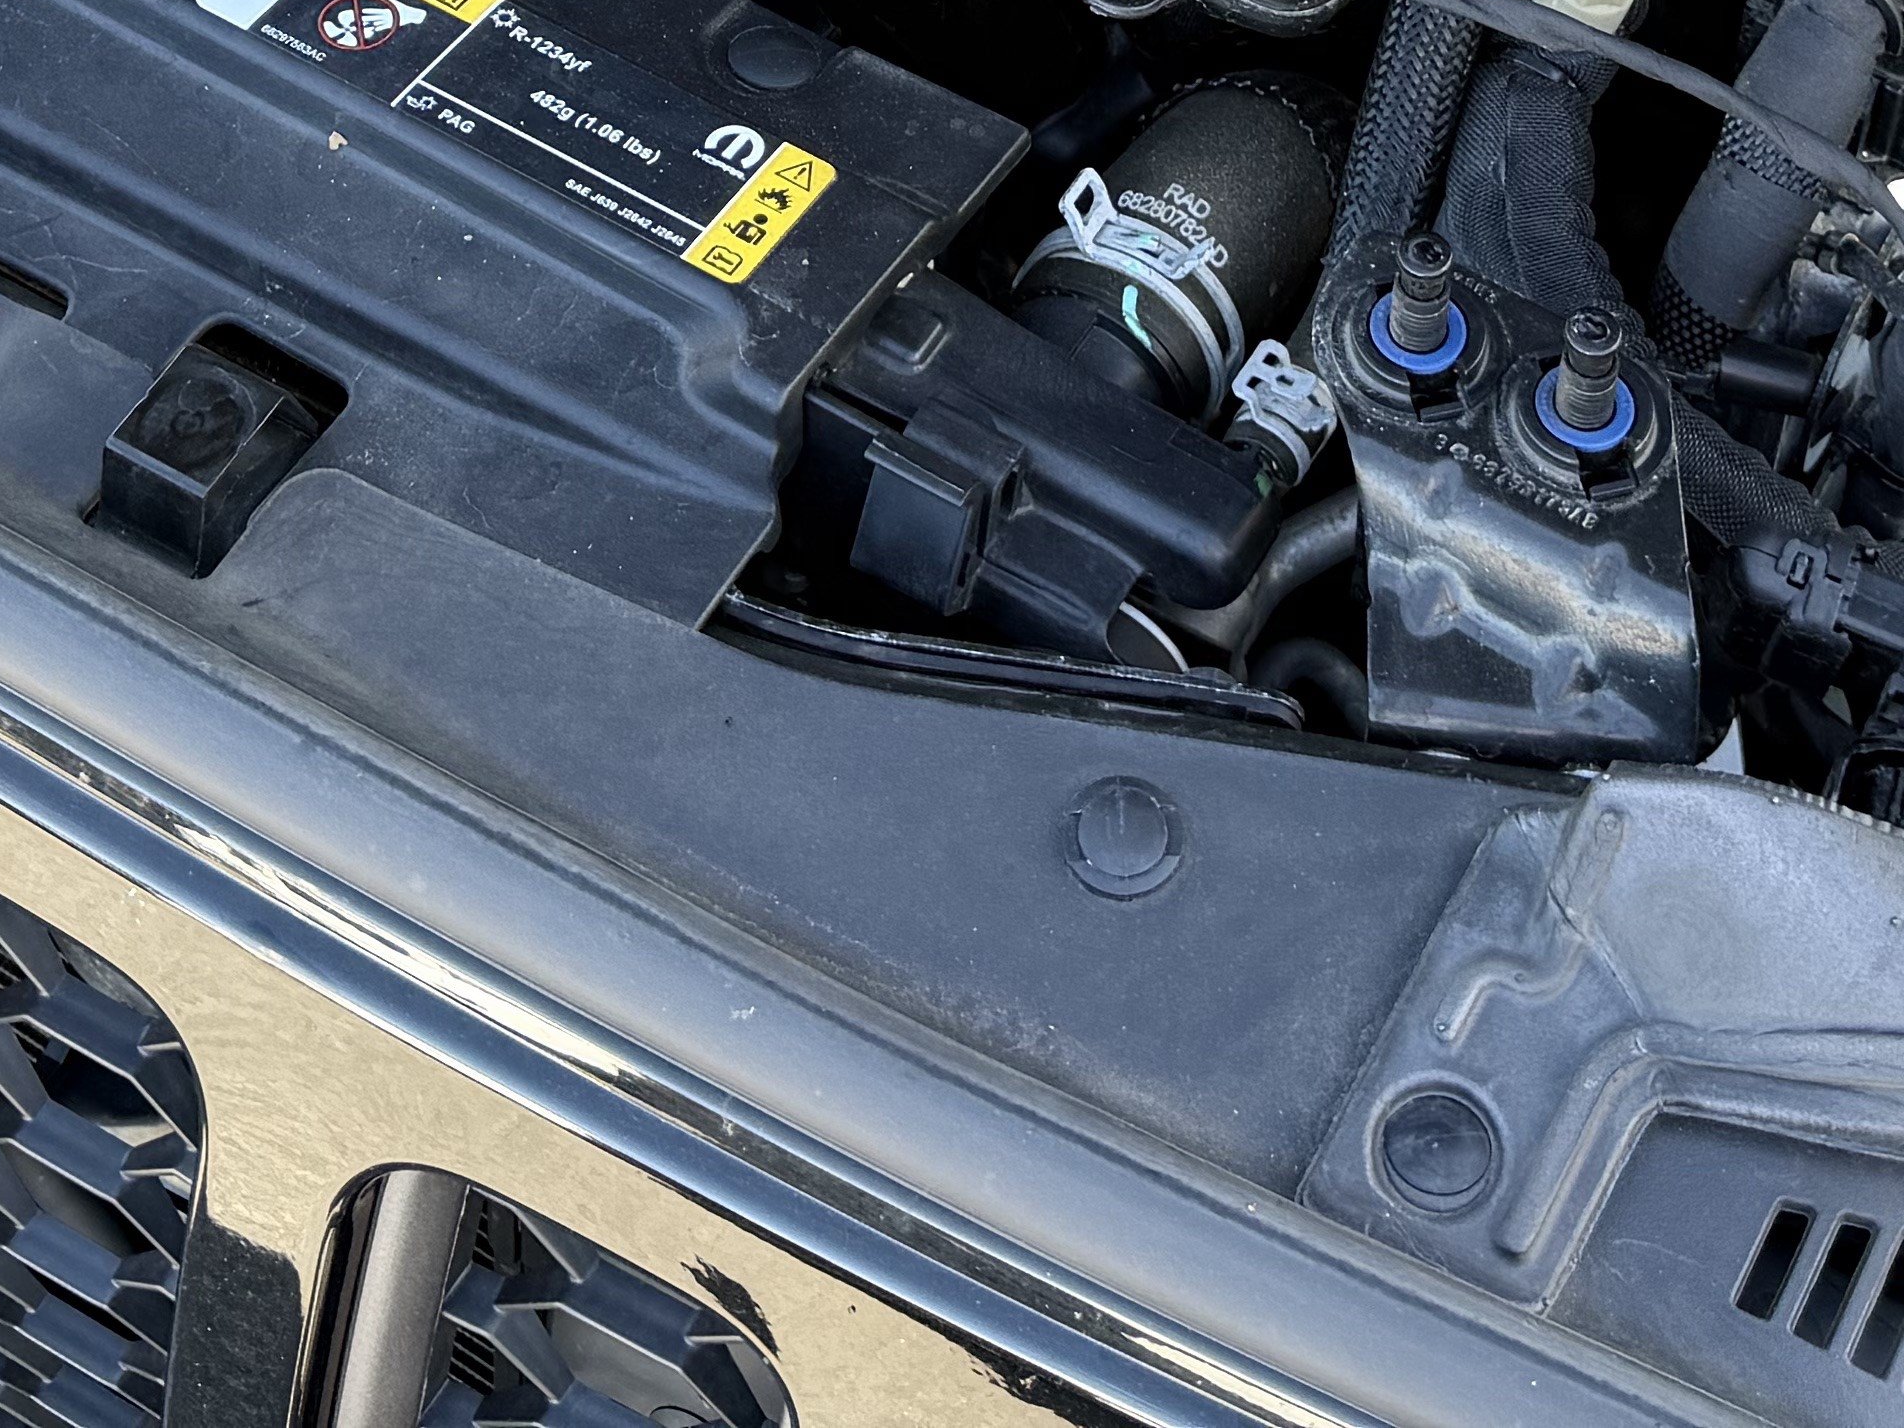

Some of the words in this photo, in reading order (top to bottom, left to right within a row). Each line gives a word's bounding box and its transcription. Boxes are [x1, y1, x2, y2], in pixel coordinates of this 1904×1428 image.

[508, 25, 593, 73] R-1234yf
[437, 108, 475, 134] PAG
[574, 113, 625, 144] (1.06
[622, 135, 661, 165] lbs)
[564, 178, 592, 198] SAE
[1163, 182, 1211, 219] RAD
